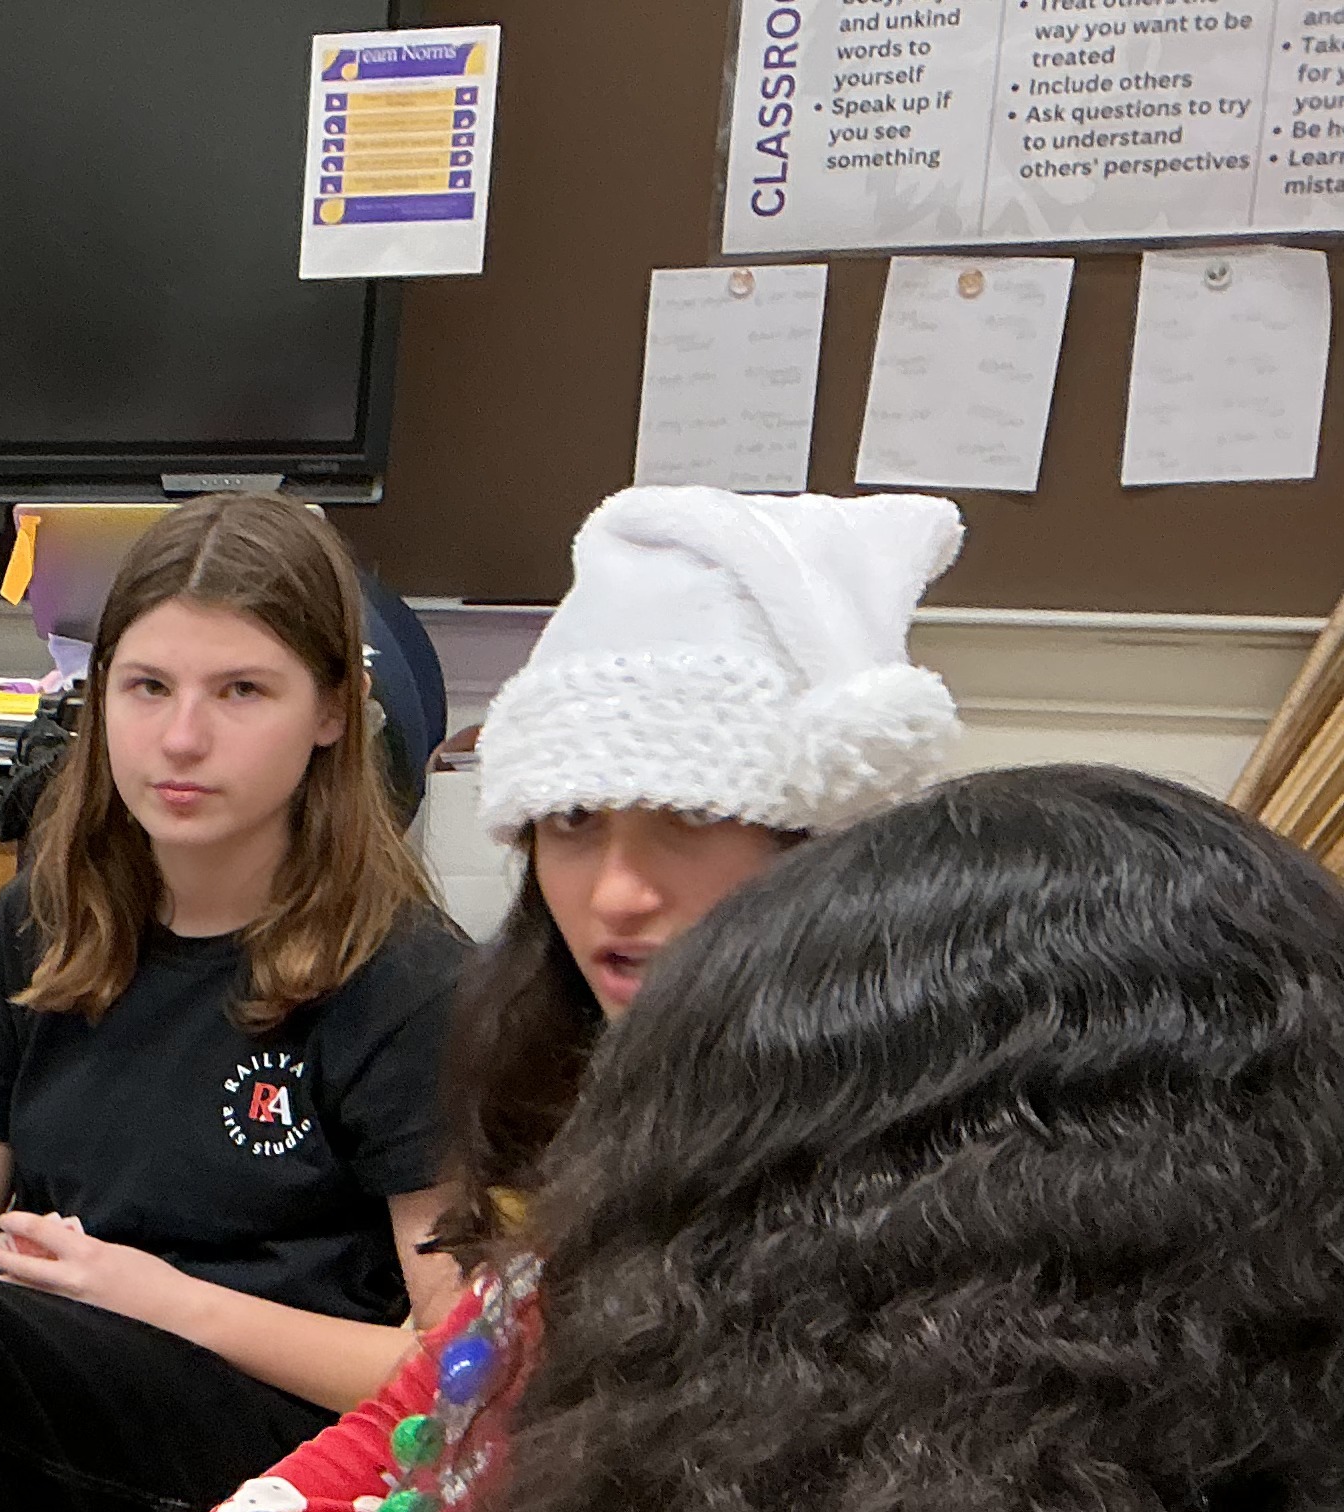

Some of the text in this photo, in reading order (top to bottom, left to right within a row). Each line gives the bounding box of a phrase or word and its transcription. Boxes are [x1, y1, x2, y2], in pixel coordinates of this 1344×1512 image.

[839, 8, 961, 32] and unkind
[1035, 12, 1253, 43] way you want to be
[837, 39, 931, 60] words to
[1302, 33, 1344, 53] Tak
[1032, 46, 1116, 67] treated
[833, 65, 927, 92] yourself
[1029, 72, 1193, 95] Include others
[1298, 63, 1333, 83] for
[751, 0, 802, 217] CLASSRO
[831, 91, 952, 118] Speak up if
[1025, 98, 1251, 125] Ask questions to try
[828, 125, 912, 147] you see
[1023, 126, 1183, 151] to understand
[1293, 120, 1321, 137] Be
[826, 148, 941, 170] something
[1020, 152, 1251, 180] others' perspectives
[224, 1052, 305, 1093] RAILYA
[252, 1118, 312, 1156] studio
